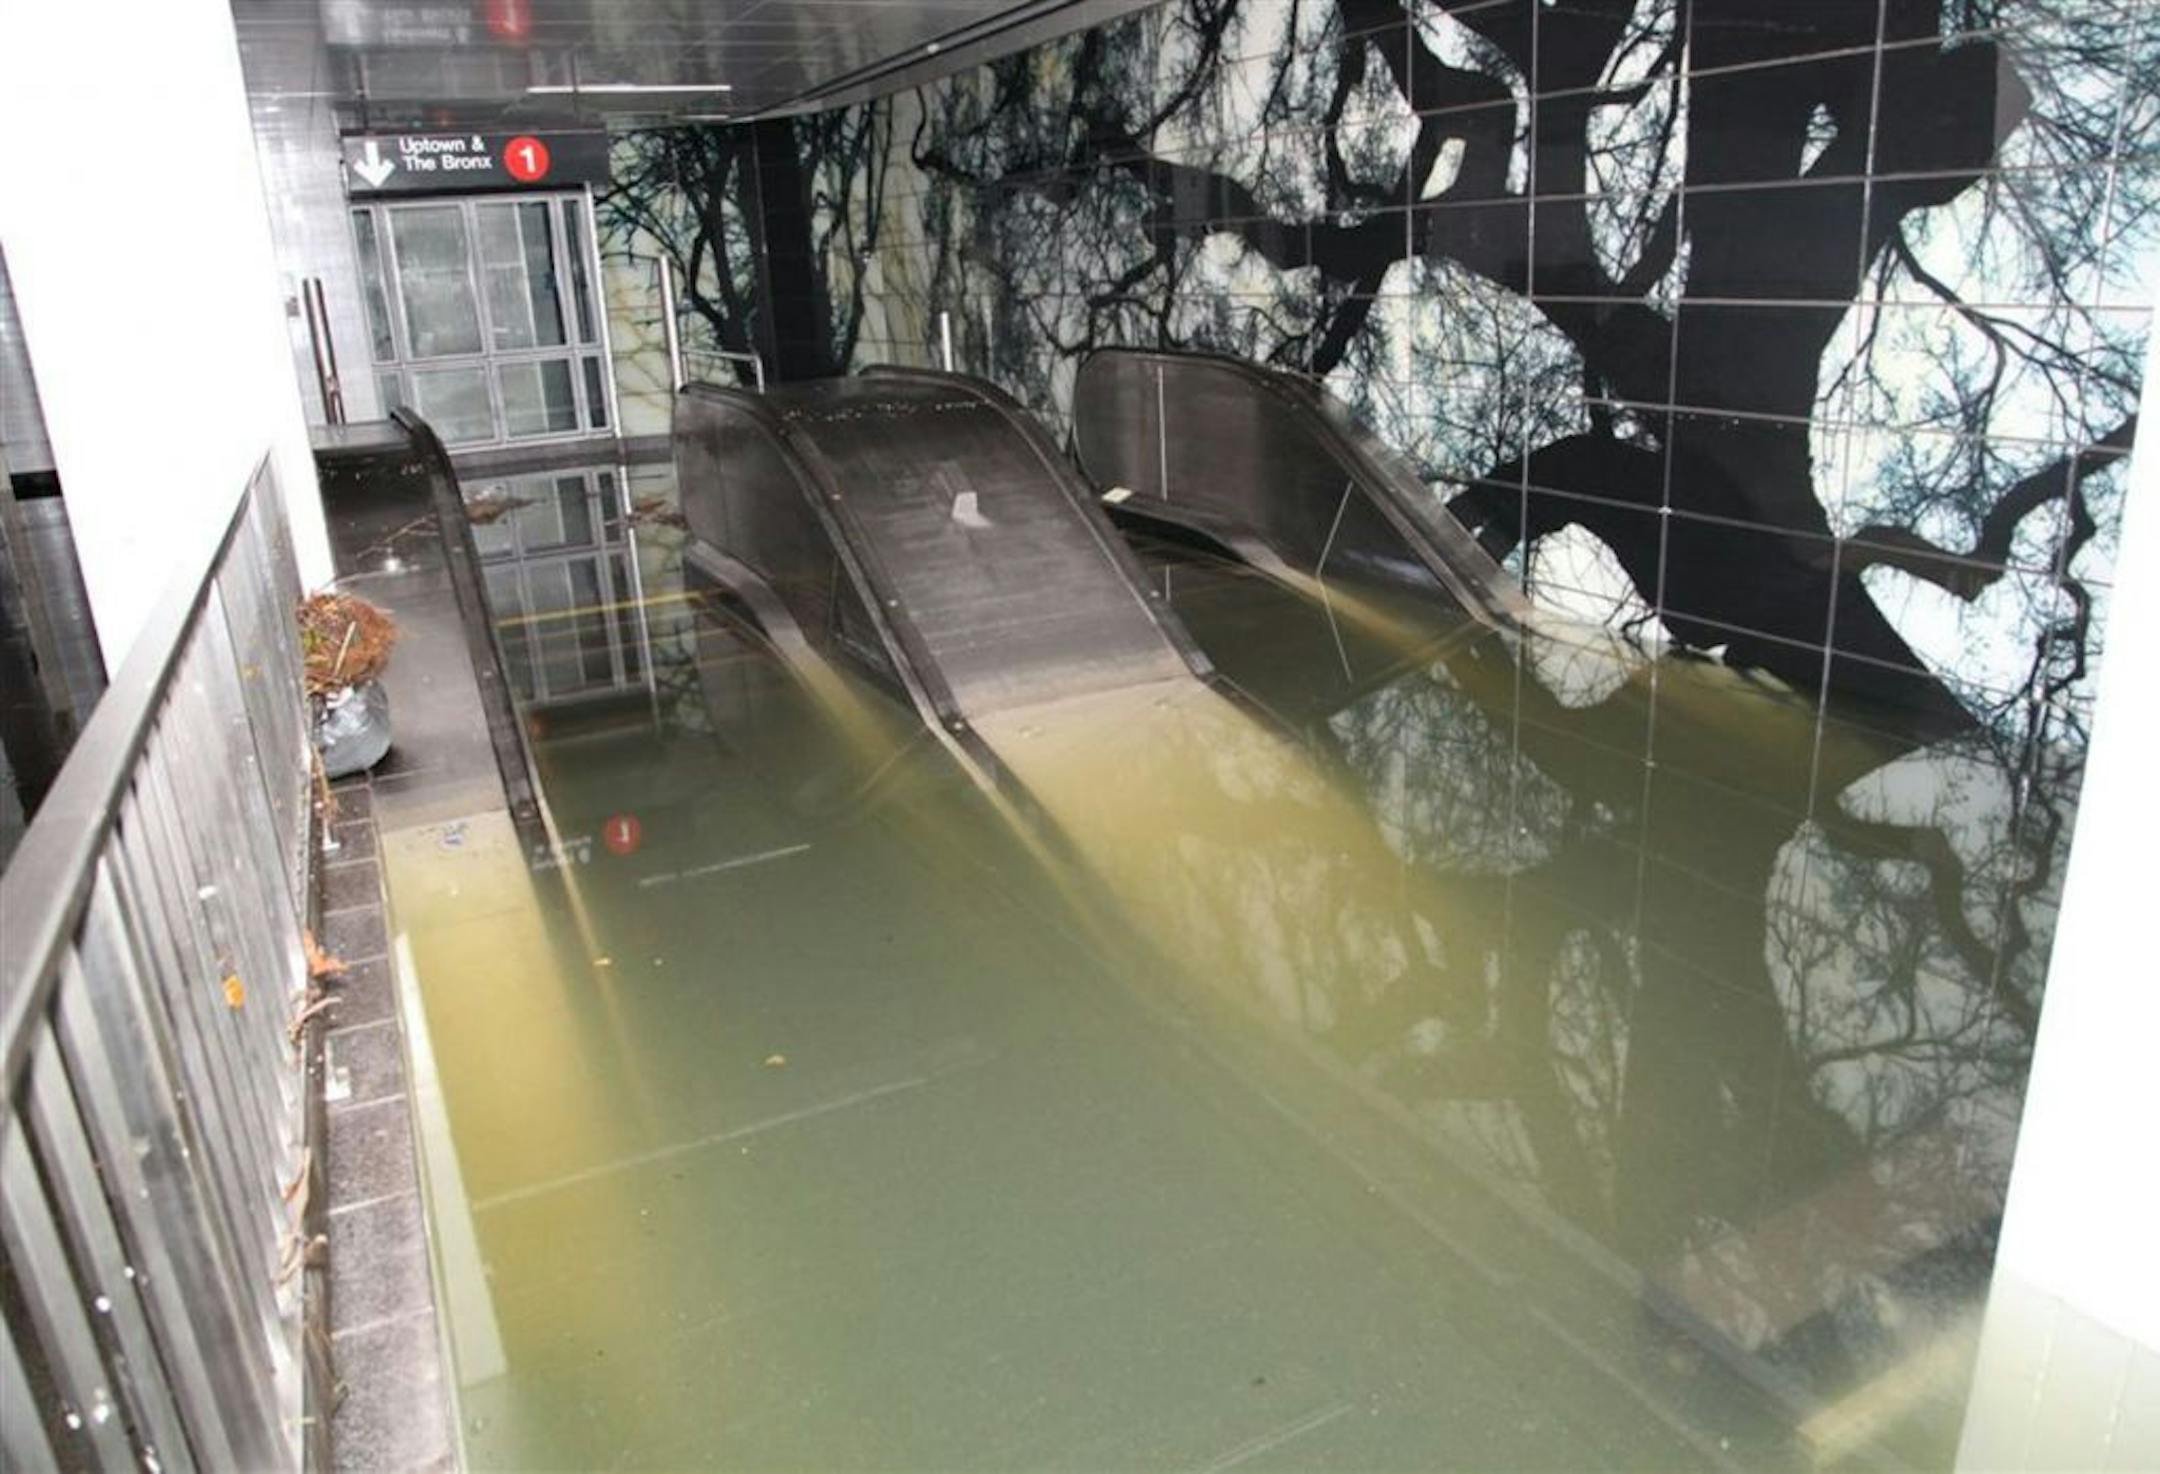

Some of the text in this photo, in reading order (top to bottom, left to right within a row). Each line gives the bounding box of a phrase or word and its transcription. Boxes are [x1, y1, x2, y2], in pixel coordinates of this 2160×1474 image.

[399, 134, 485, 154] Uptown &
[402, 153, 493, 171] The Bronx
[519, 145, 536, 173] 1
